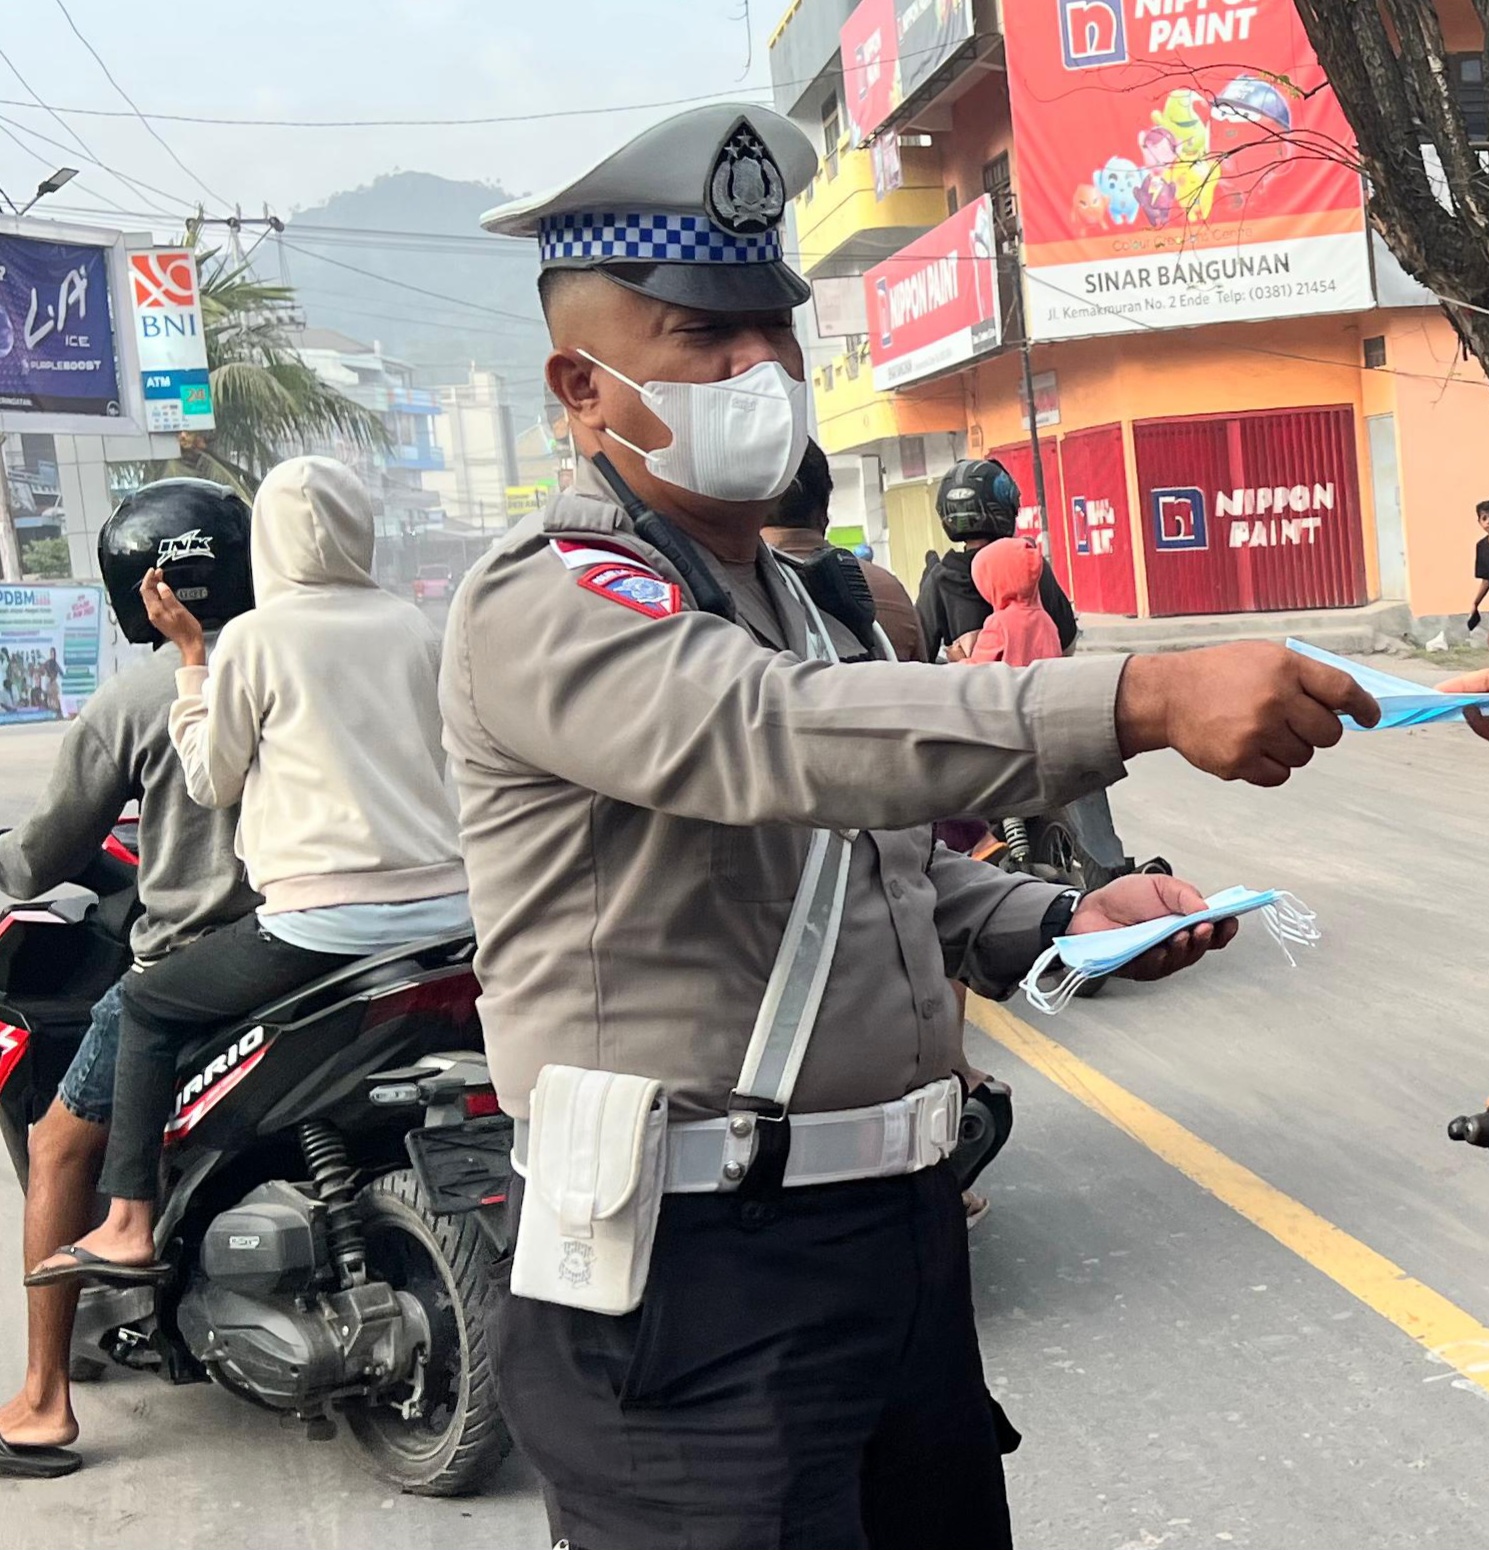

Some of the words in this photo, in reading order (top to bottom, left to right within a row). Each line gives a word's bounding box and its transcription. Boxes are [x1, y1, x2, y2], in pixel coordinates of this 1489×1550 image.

[1149, 7, 1257, 52] PAINT
[1085, 268, 1151, 293] SINAR
[1158, 252, 1290, 286] BANGUNAN
[1062, 302, 1142, 320] Kemakmuran
[1145, 298, 1166, 311] No.
[1169, 296, 1177, 308] 2
[1180, 294, 1210, 308] Ende
[1249, 284, 1292, 300] (0381)
[1296, 279, 1337, 295] 21454
[65, 335, 90, 347] ICE
[141, 313, 197, 338] BNI
[146, 376, 171, 388] ATM
[1215, 482, 1334, 517] NIPPON
[1229, 516, 1322, 548] PAINT
